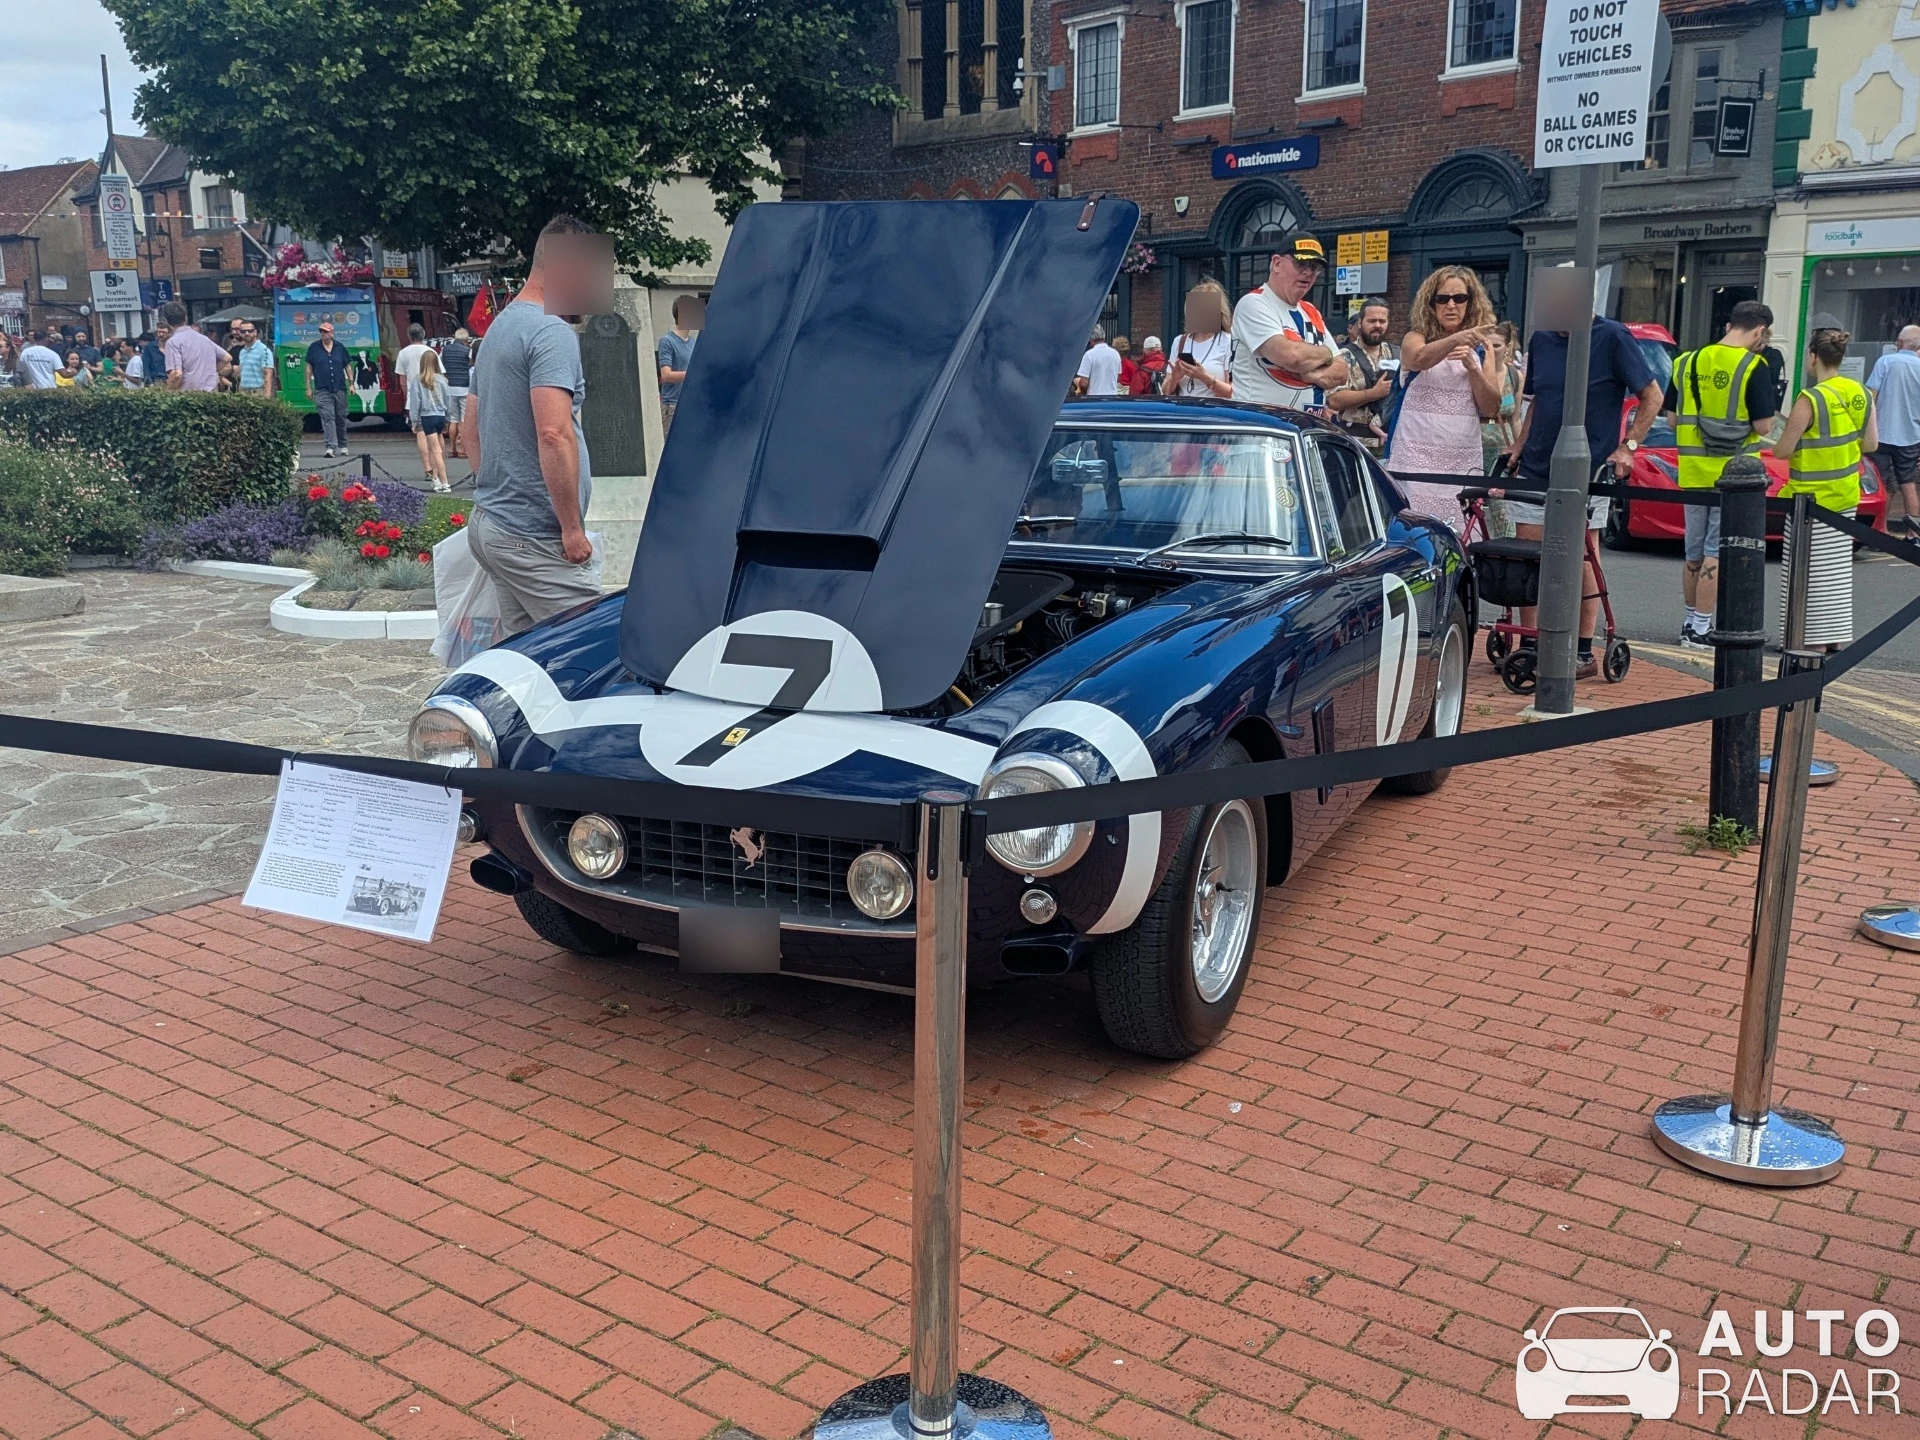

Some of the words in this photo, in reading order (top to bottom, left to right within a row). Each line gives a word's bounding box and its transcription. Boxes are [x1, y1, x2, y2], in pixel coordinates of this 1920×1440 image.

[1568, 6, 1589, 24] DO
[1593, 0, 1628, 20] NOT
[1569, 22, 1623, 45] TOUCH
[1557, 43, 1632, 68] VEHICLES
[1546, 73, 1573, 84] WITHOUT
[1573, 69, 1600, 80] OWNERS
[1600, 65, 1642, 77] PERMISSION
[1577, 91, 1600, 108] NO
[1543, 115, 1578, 133] BALL
[1581, 109, 1637, 129] GAMES
[1544, 137, 1564, 154] OR
[1567, 131, 1634, 151] CYCLING
[1237, 147, 1301, 168] nationwide
[1526, 235, 1537, 246] 73
[1643, 225, 1702, 241] Broadway
[1703, 222, 1752, 237] Barbers
[1824, 230, 1863, 241] foodbank
[452, 271, 483, 287] PHOENIX
[460, 286, 477, 294] VAPERS
[1383, 584, 1410, 744] 7
[674, 632, 834, 768] 7
